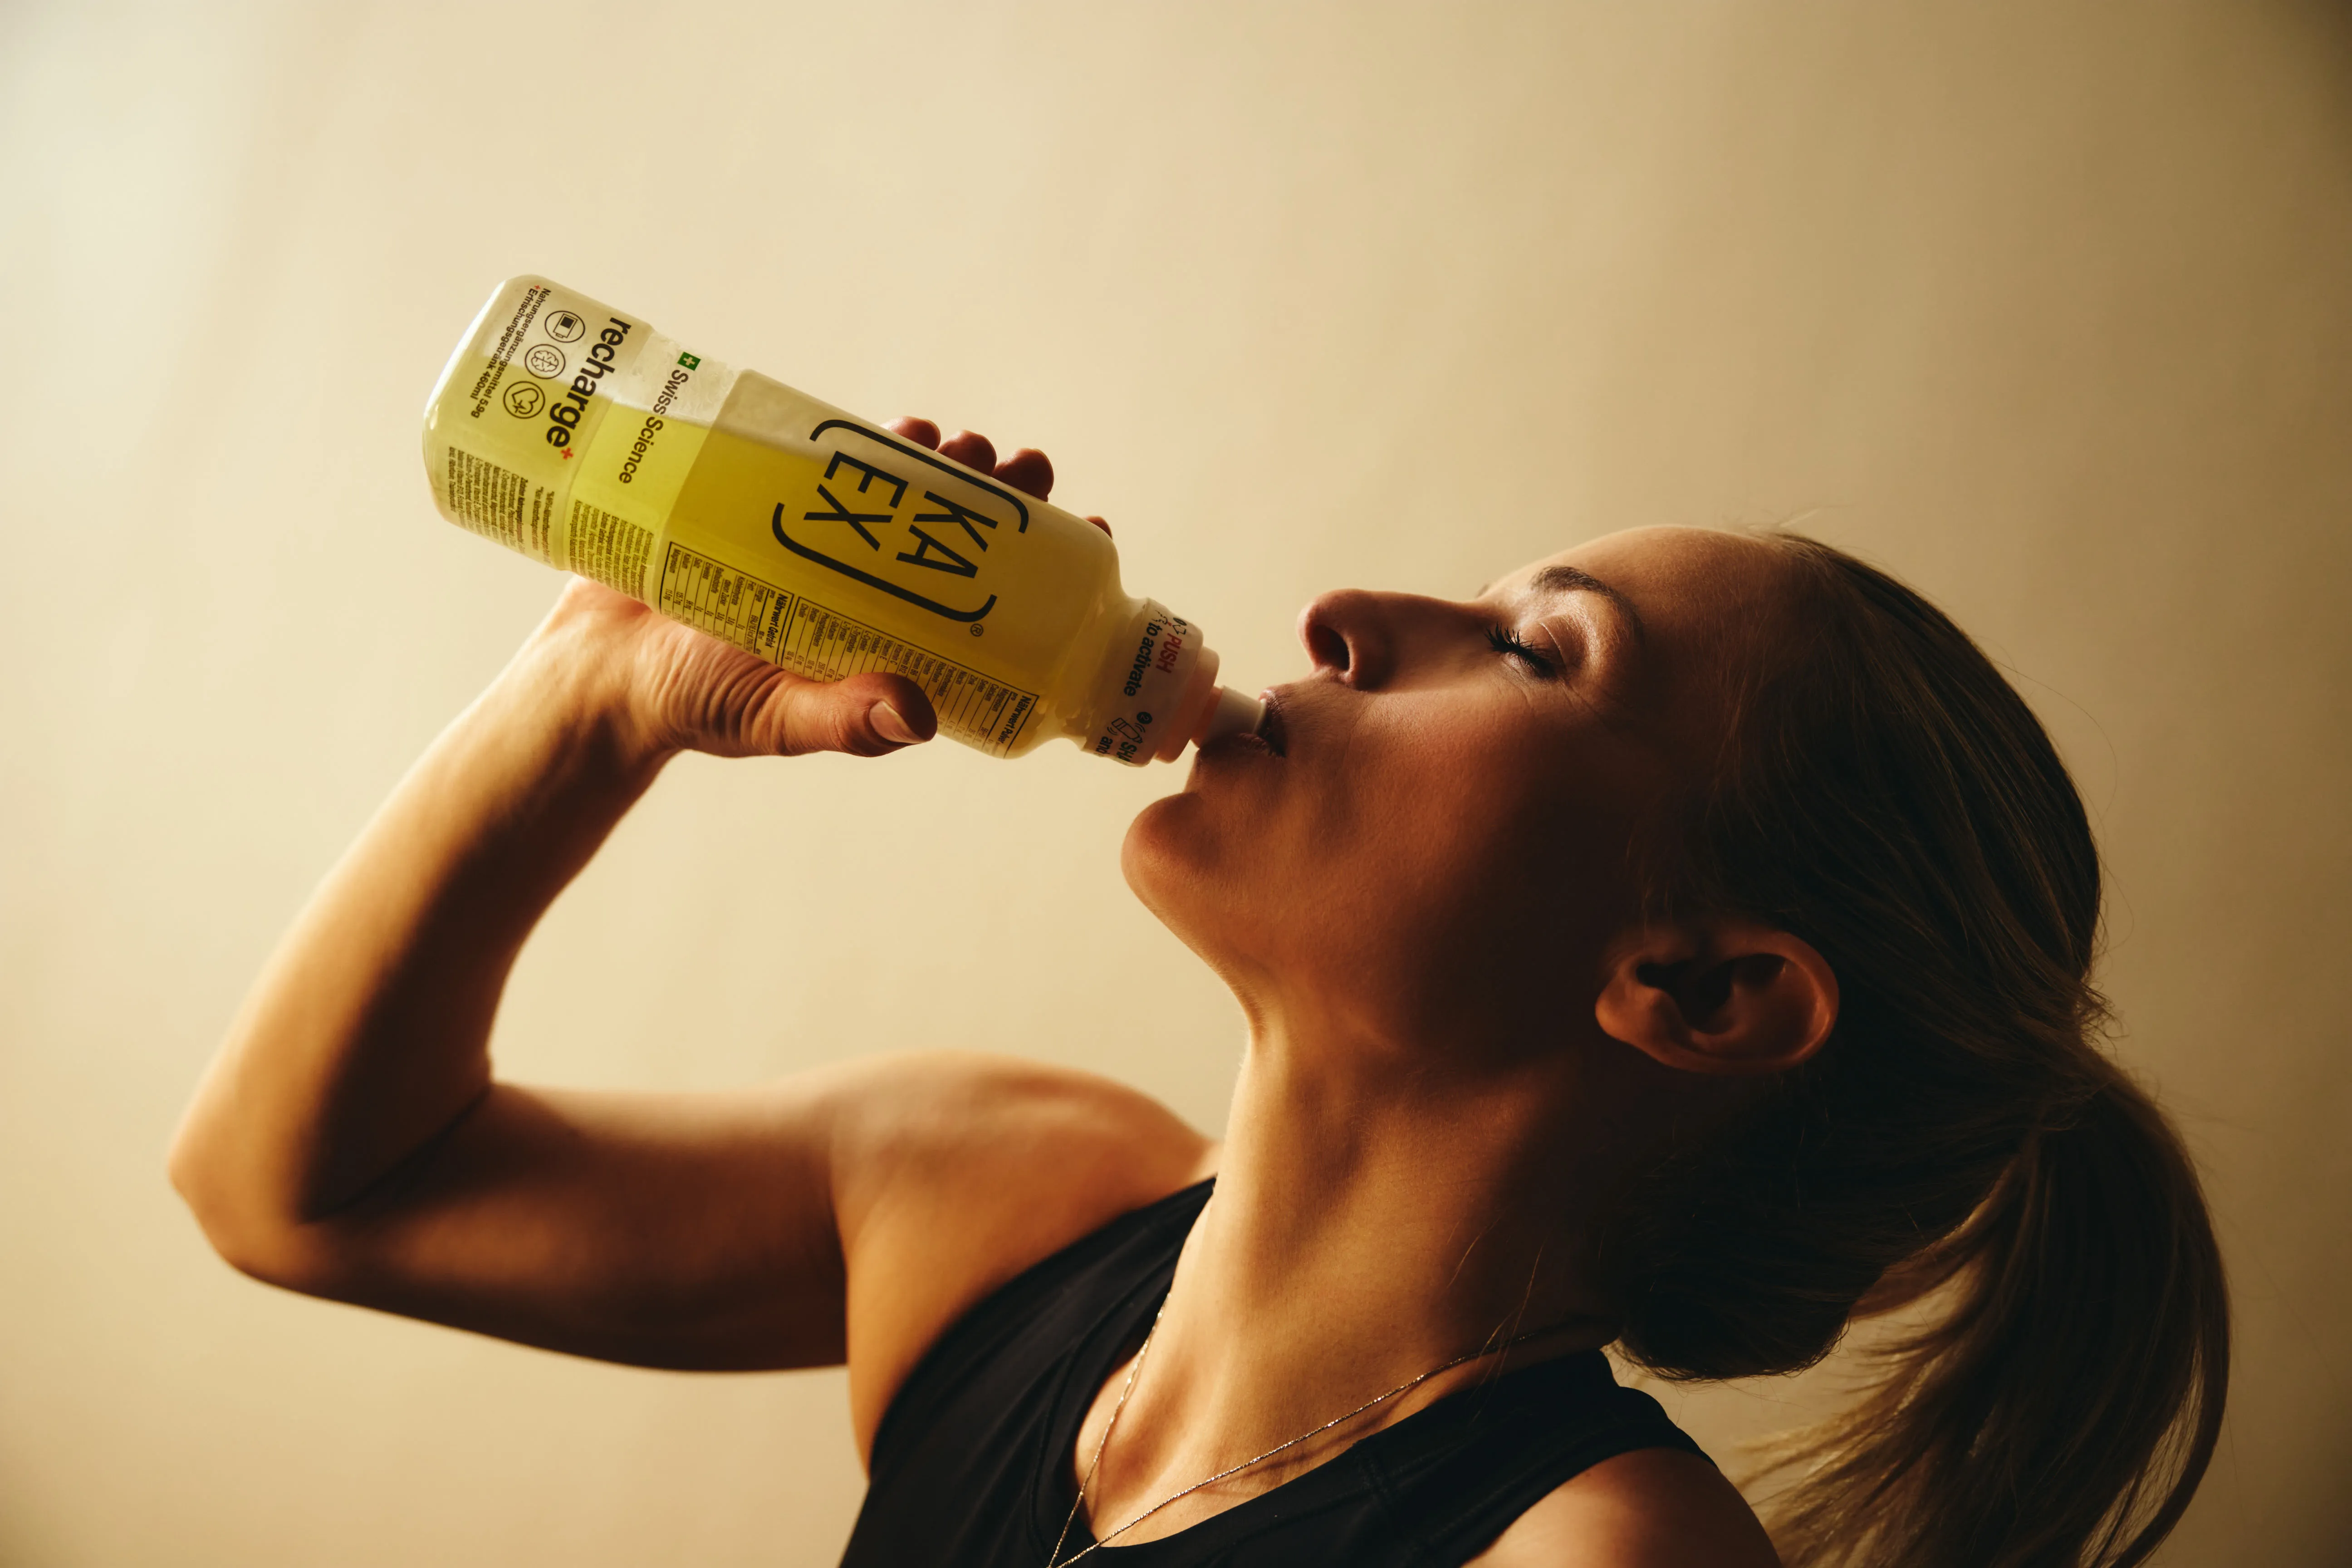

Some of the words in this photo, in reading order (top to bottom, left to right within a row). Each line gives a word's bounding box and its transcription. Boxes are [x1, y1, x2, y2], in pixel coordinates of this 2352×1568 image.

[484, 288, 551, 398] Nahrungsergänzungsmittel
[470, 371, 491, 400] 460ml
[653, 370, 689, 415] Swiss
[619, 416, 663, 483] Science
[804, 451, 909, 551] EX
[896, 490, 998, 578] KA
[769, 593, 788, 627] Nährwert
[1147, 622, 1162, 636] to
[765, 627, 779, 648] Getränk
[1156, 633, 1182, 673] PUSH
[1124, 637, 1154, 696] activate
[1006, 695, 1031, 729] Nährwert
[998, 727, 1013, 744] Pulver
